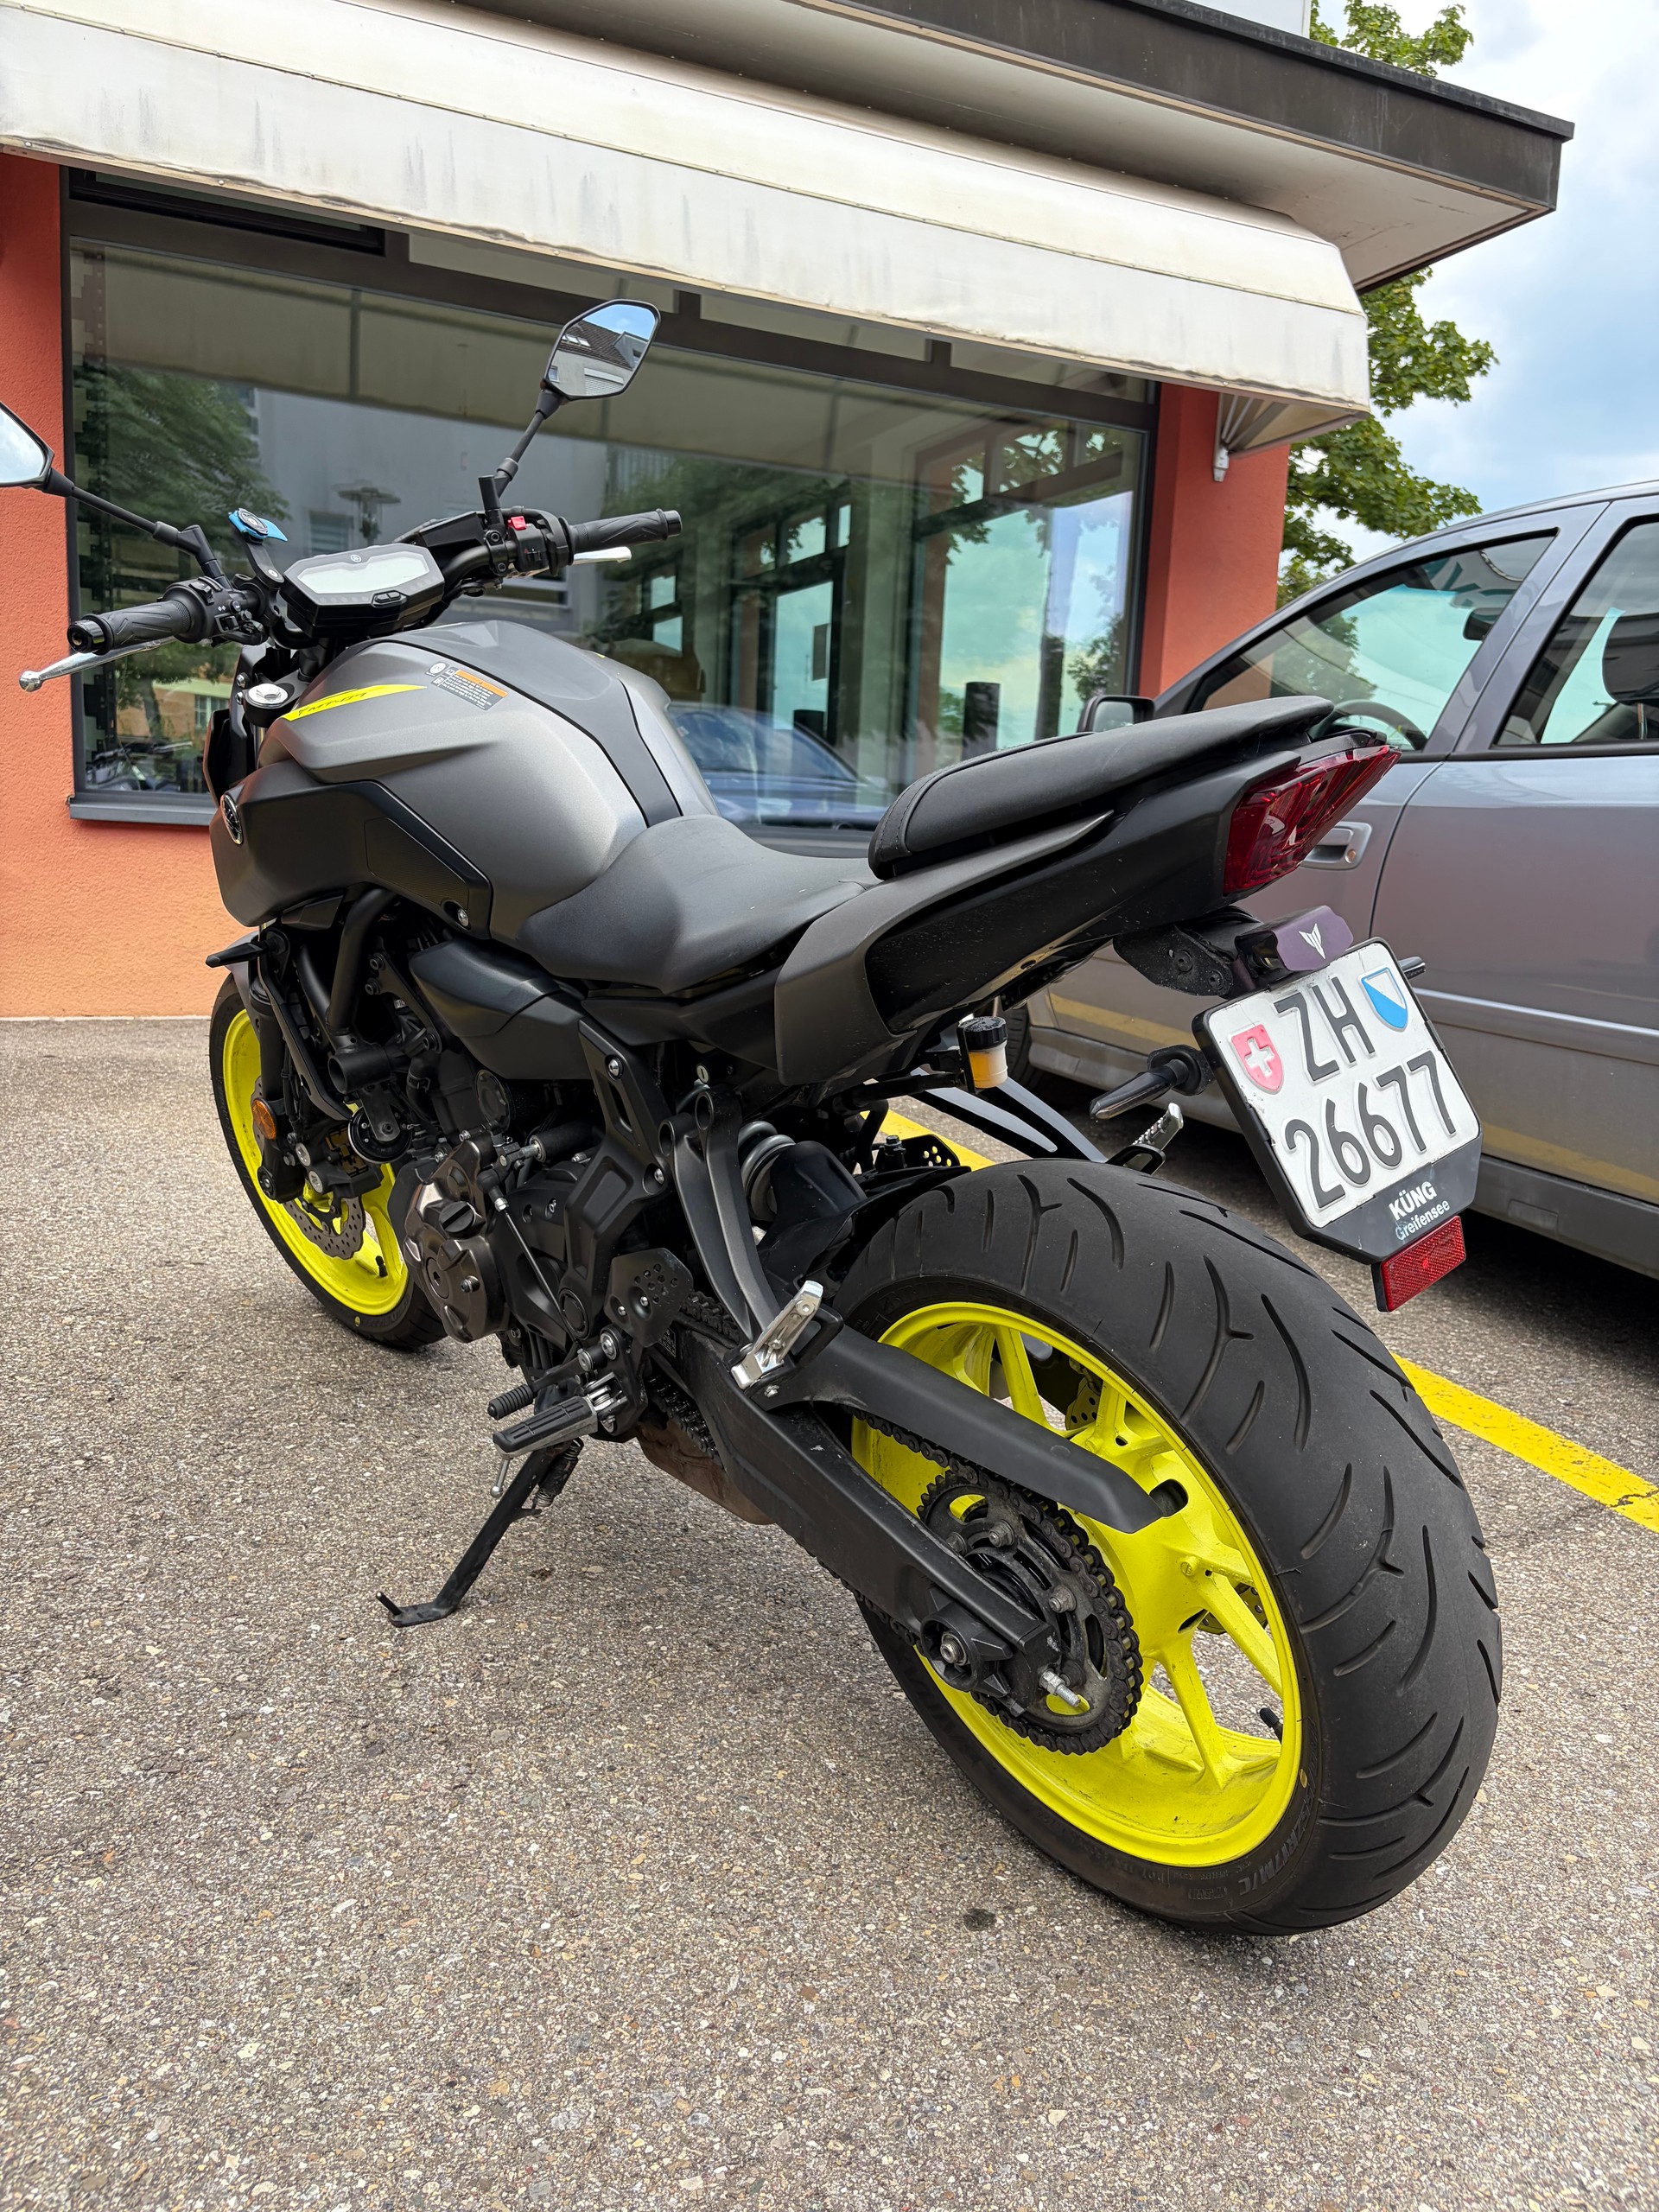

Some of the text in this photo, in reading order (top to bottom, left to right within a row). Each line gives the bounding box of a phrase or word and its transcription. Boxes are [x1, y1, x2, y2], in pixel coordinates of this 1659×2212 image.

[1274, 976, 1376, 1082] ZH
[1284, 1050, 1456, 1209] 26677
[1389, 1181, 1437, 1221] KÜNG
[1395, 1200, 1450, 1241] Greifensee
